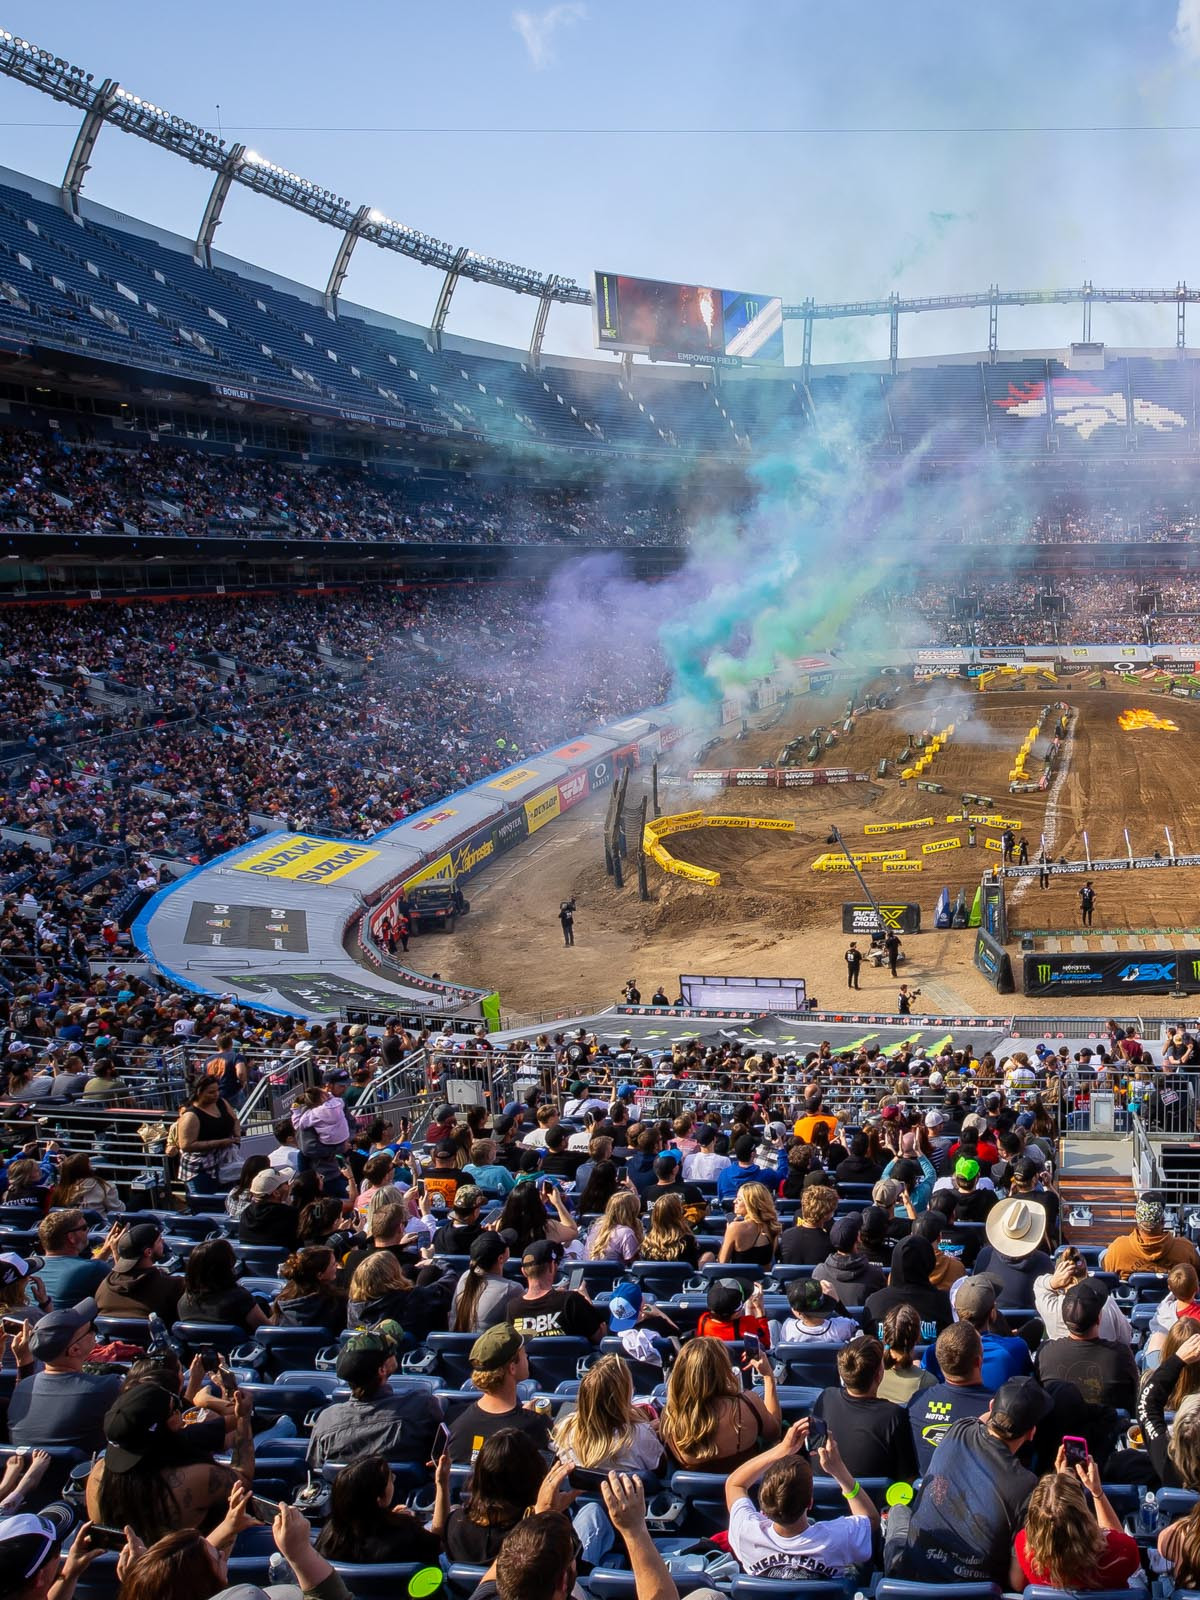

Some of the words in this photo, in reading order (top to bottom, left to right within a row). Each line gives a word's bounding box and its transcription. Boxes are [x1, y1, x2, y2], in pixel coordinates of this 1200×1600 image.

[677, 352, 716, 363] EMPOWER
[717, 357, 738, 365] FIELD
[223, 388, 248, 399] BOWLEN
[533, 795, 557, 818] DUNLOP
[498, 816, 522, 838] MONSTER
[868, 825, 898, 833] SUZUKI
[925, 840, 959, 852] SUZUKI
[250, 839, 327, 873] SUZUKI
[871, 853, 904, 861] SUZUKI
[296, 847, 368, 881] SUZUKI
[925, 1412, 950, 1421] MOTO-X
[926, 1549, 947, 1562] Feliz
